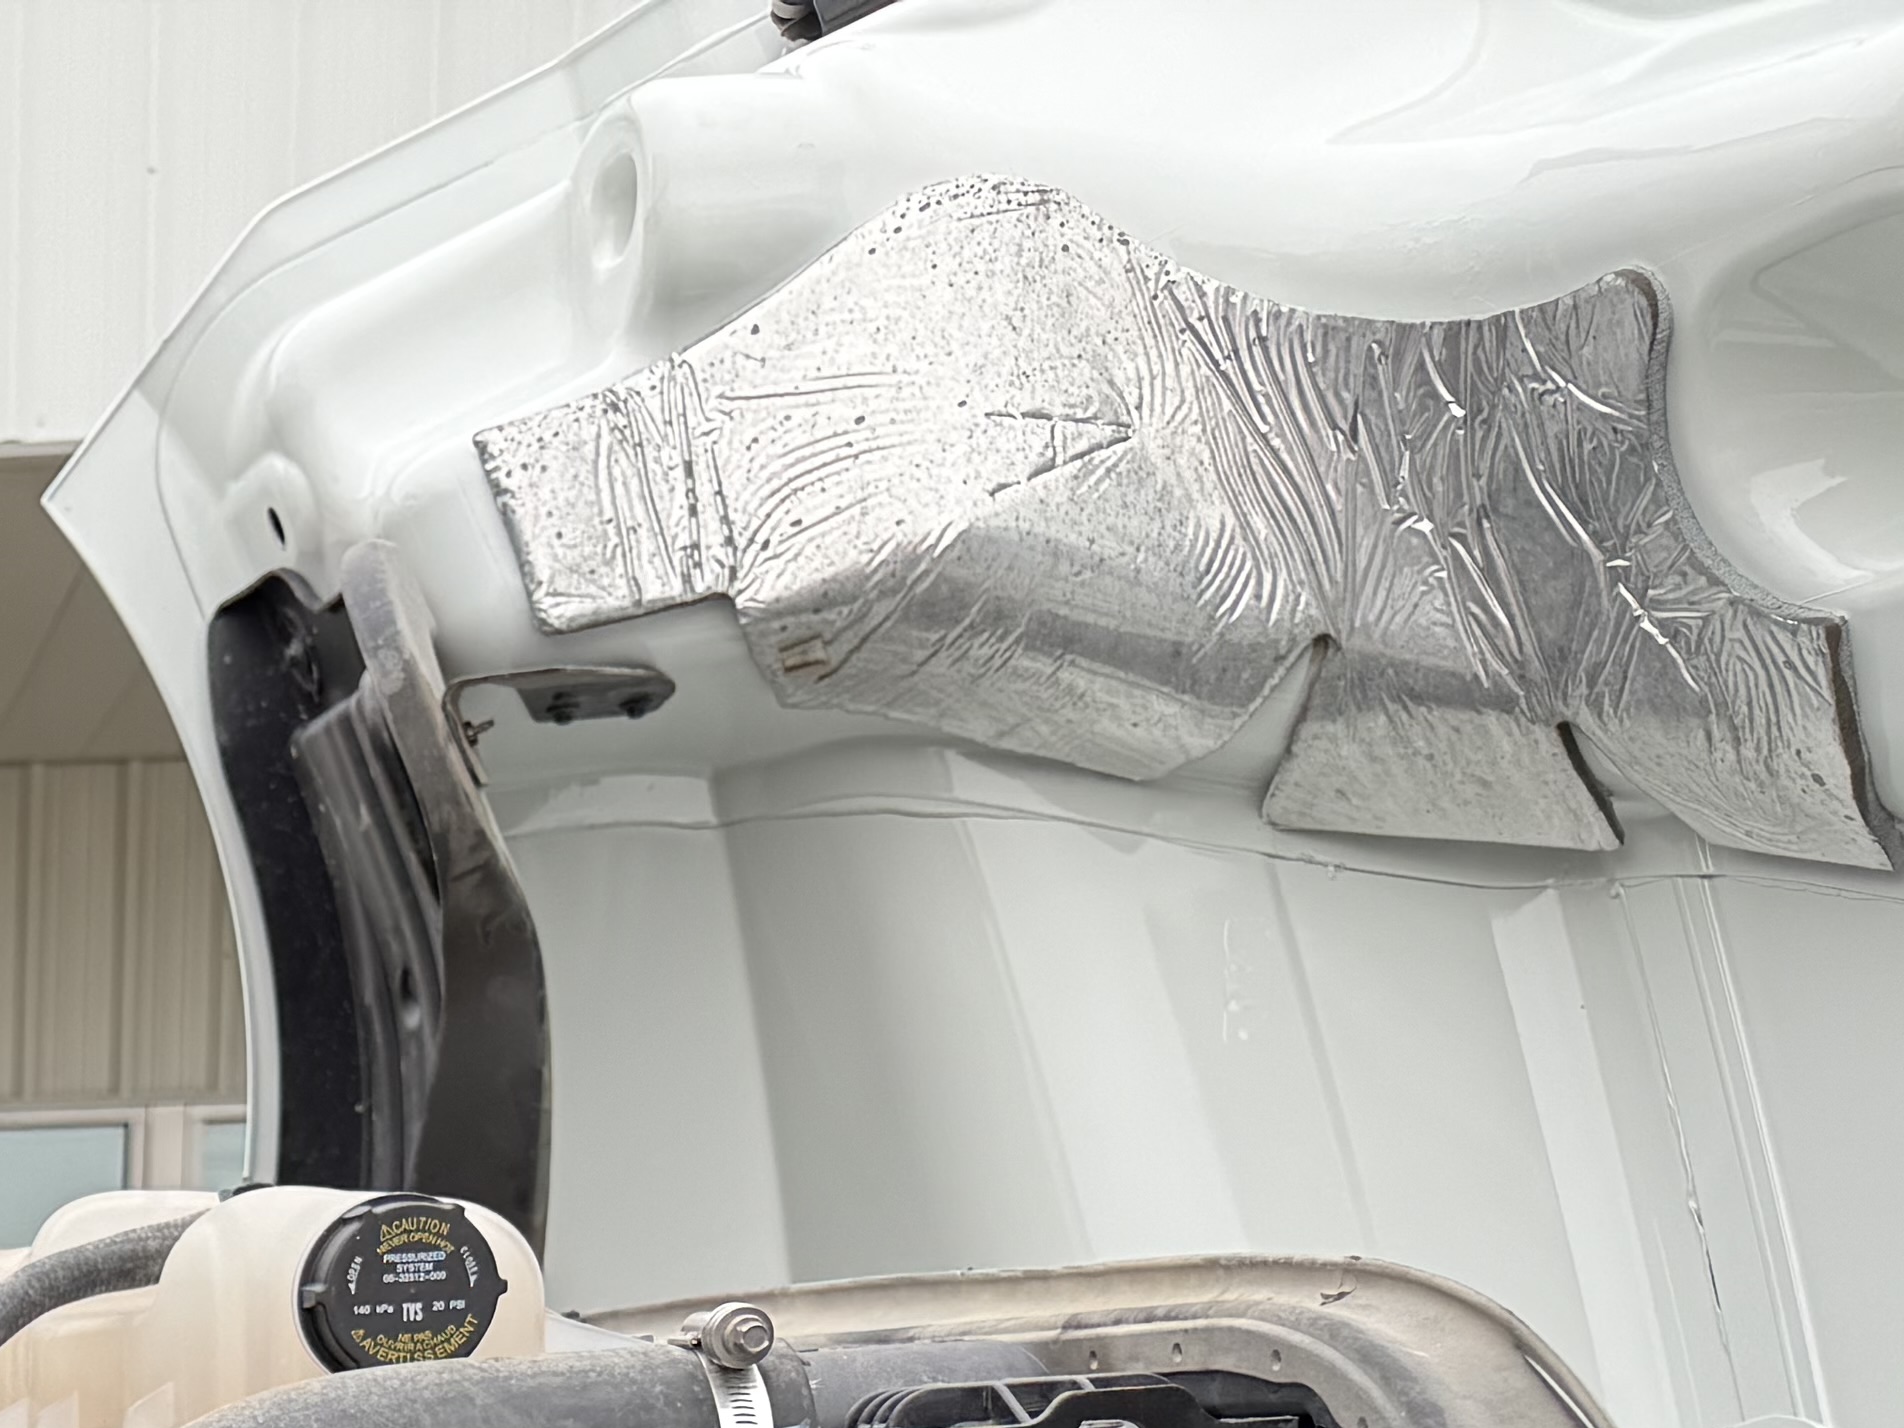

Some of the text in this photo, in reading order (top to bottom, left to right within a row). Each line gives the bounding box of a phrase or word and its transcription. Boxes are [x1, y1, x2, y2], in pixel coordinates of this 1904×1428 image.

[392, 1217, 450, 1235] CAUTION
[383, 1251, 446, 1263] PRESSURIZED
[396, 1262, 434, 1273] SYSTEM
[402, 1302, 423, 1322] TVS
[432, 1301, 444, 1311] 20
[449, 1299, 465, 1310] PSI
[360, 1313, 479, 1364] AVERTISSEMENT
